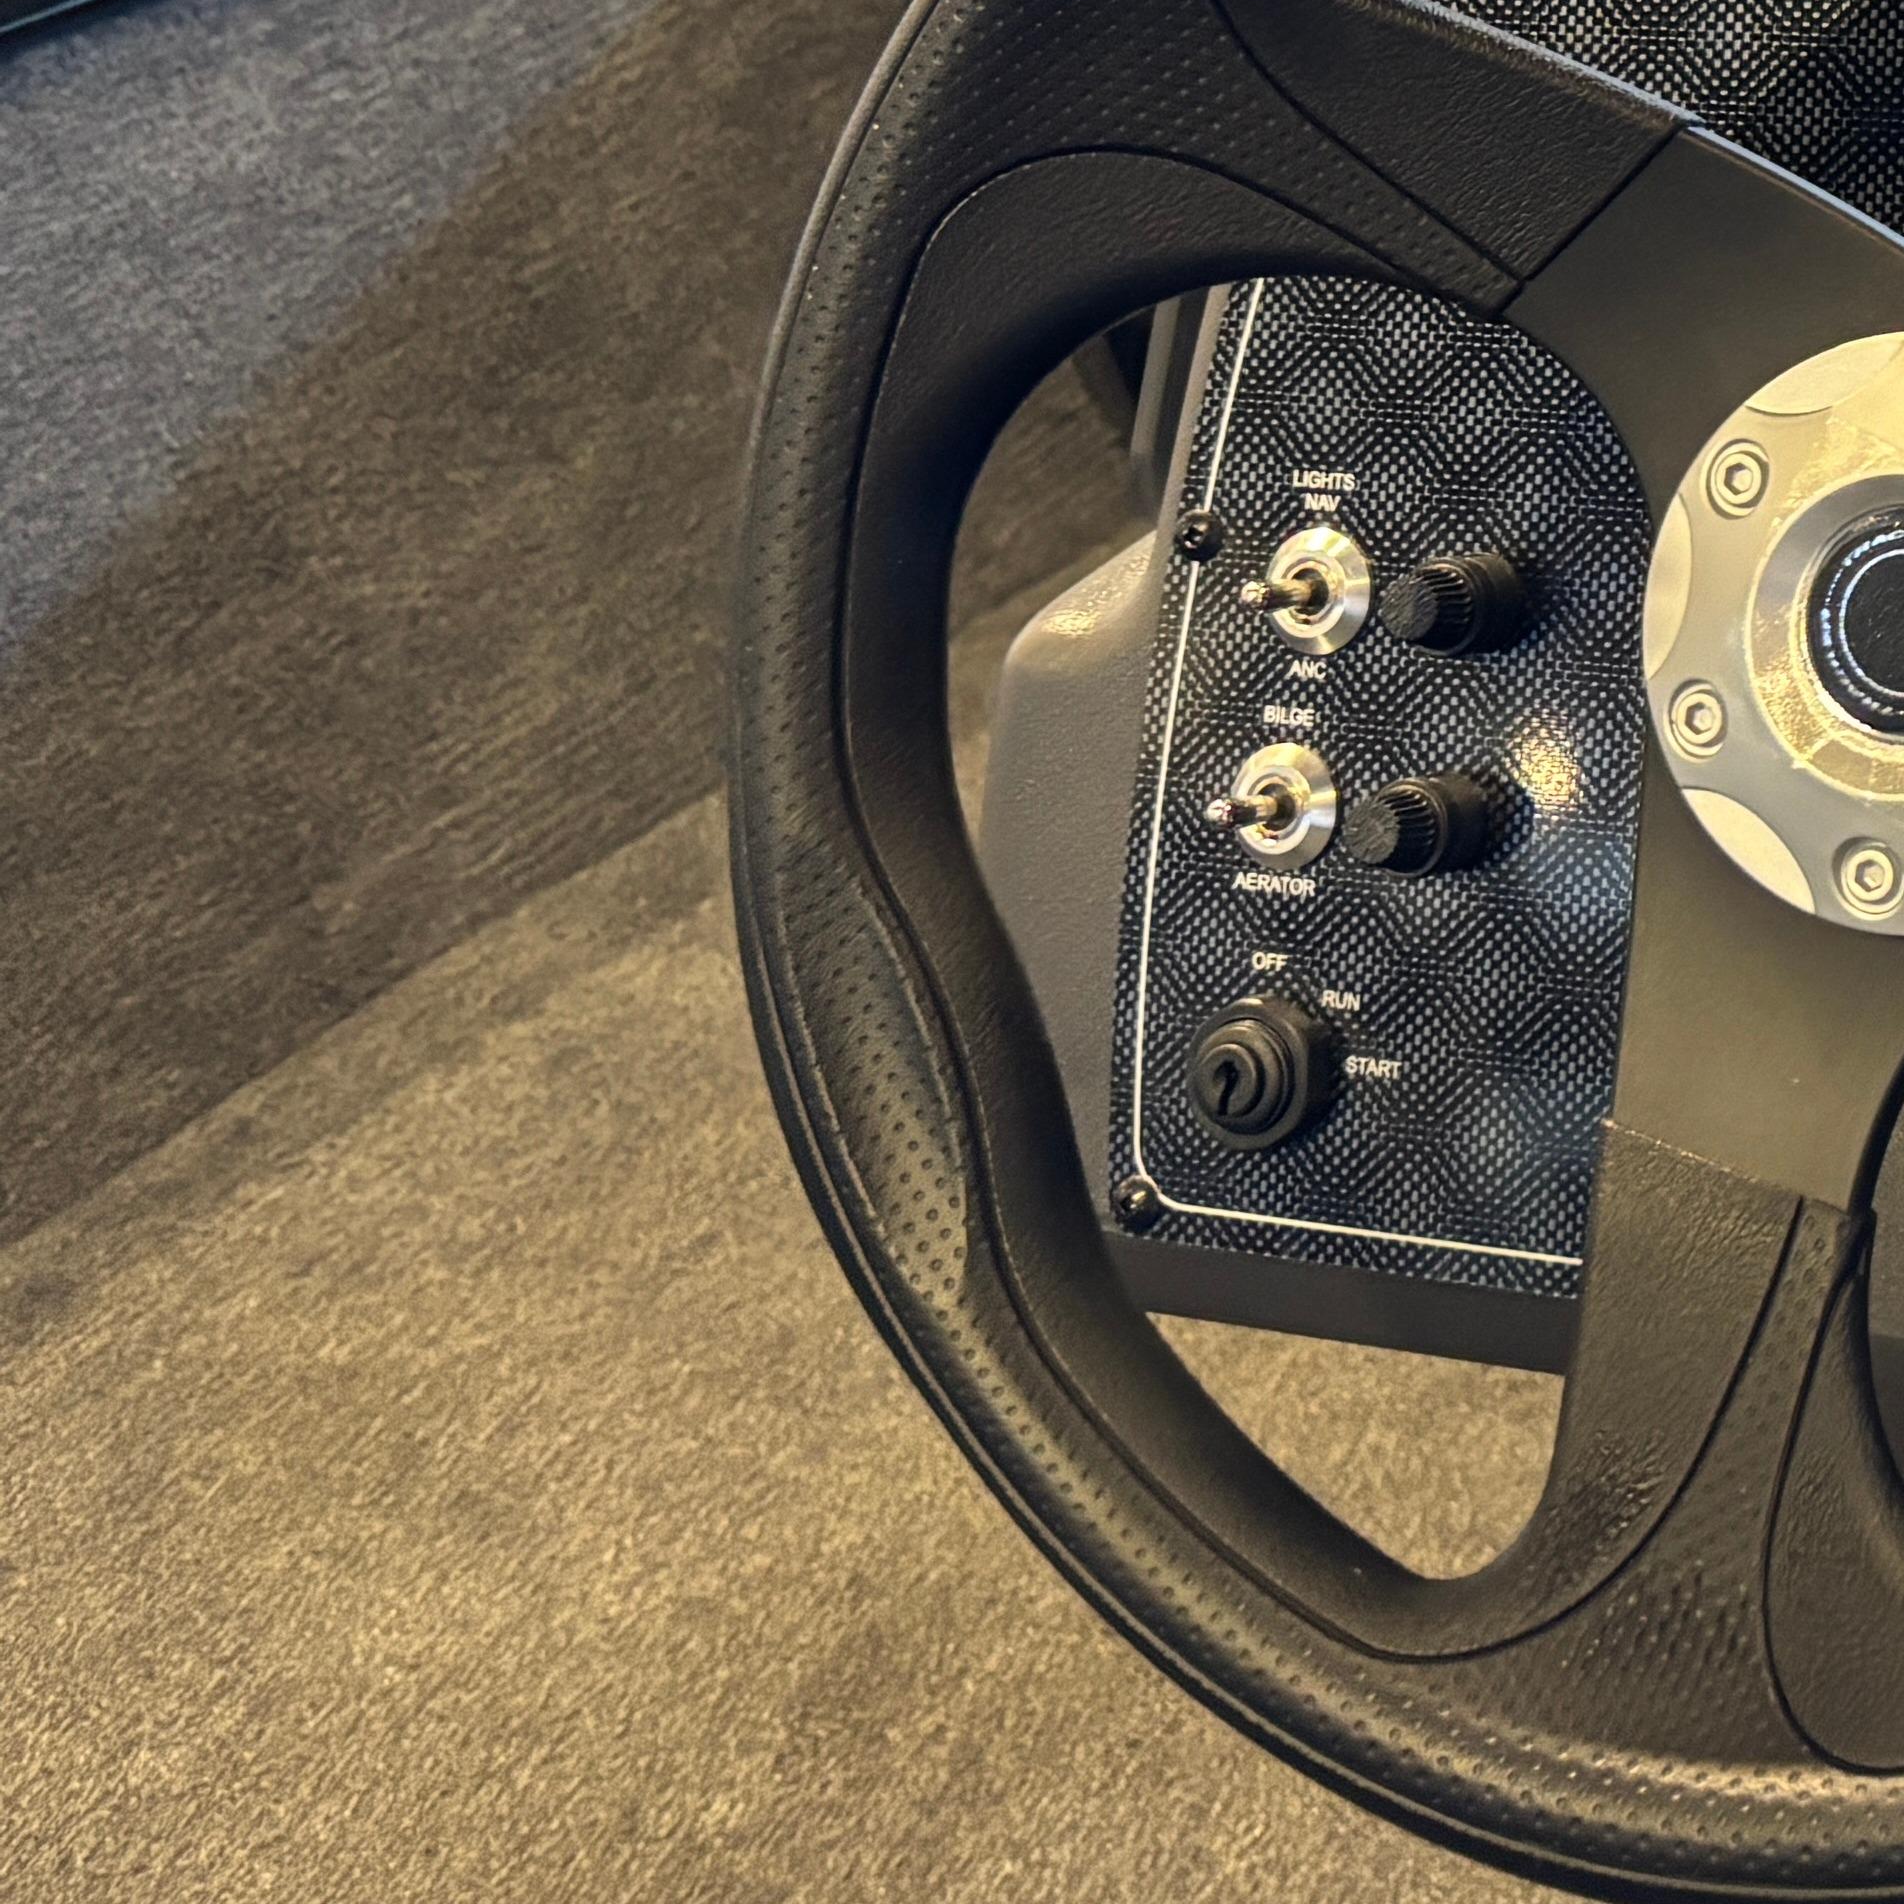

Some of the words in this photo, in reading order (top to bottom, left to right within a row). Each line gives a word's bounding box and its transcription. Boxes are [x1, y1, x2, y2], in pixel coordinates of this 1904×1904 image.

[1292, 469, 1356, 491] LIGHTS
[1304, 493, 1341, 512] NAV
[1288, 660, 1327, 680] ANC
[1264, 705, 1316, 727] BILGE
[1231, 872, 1316, 897] AERATOR
[1252, 952, 1288, 972] OFF
[1321, 990, 1361, 1011] RUN
[1345, 1056, 1402, 1080] START
